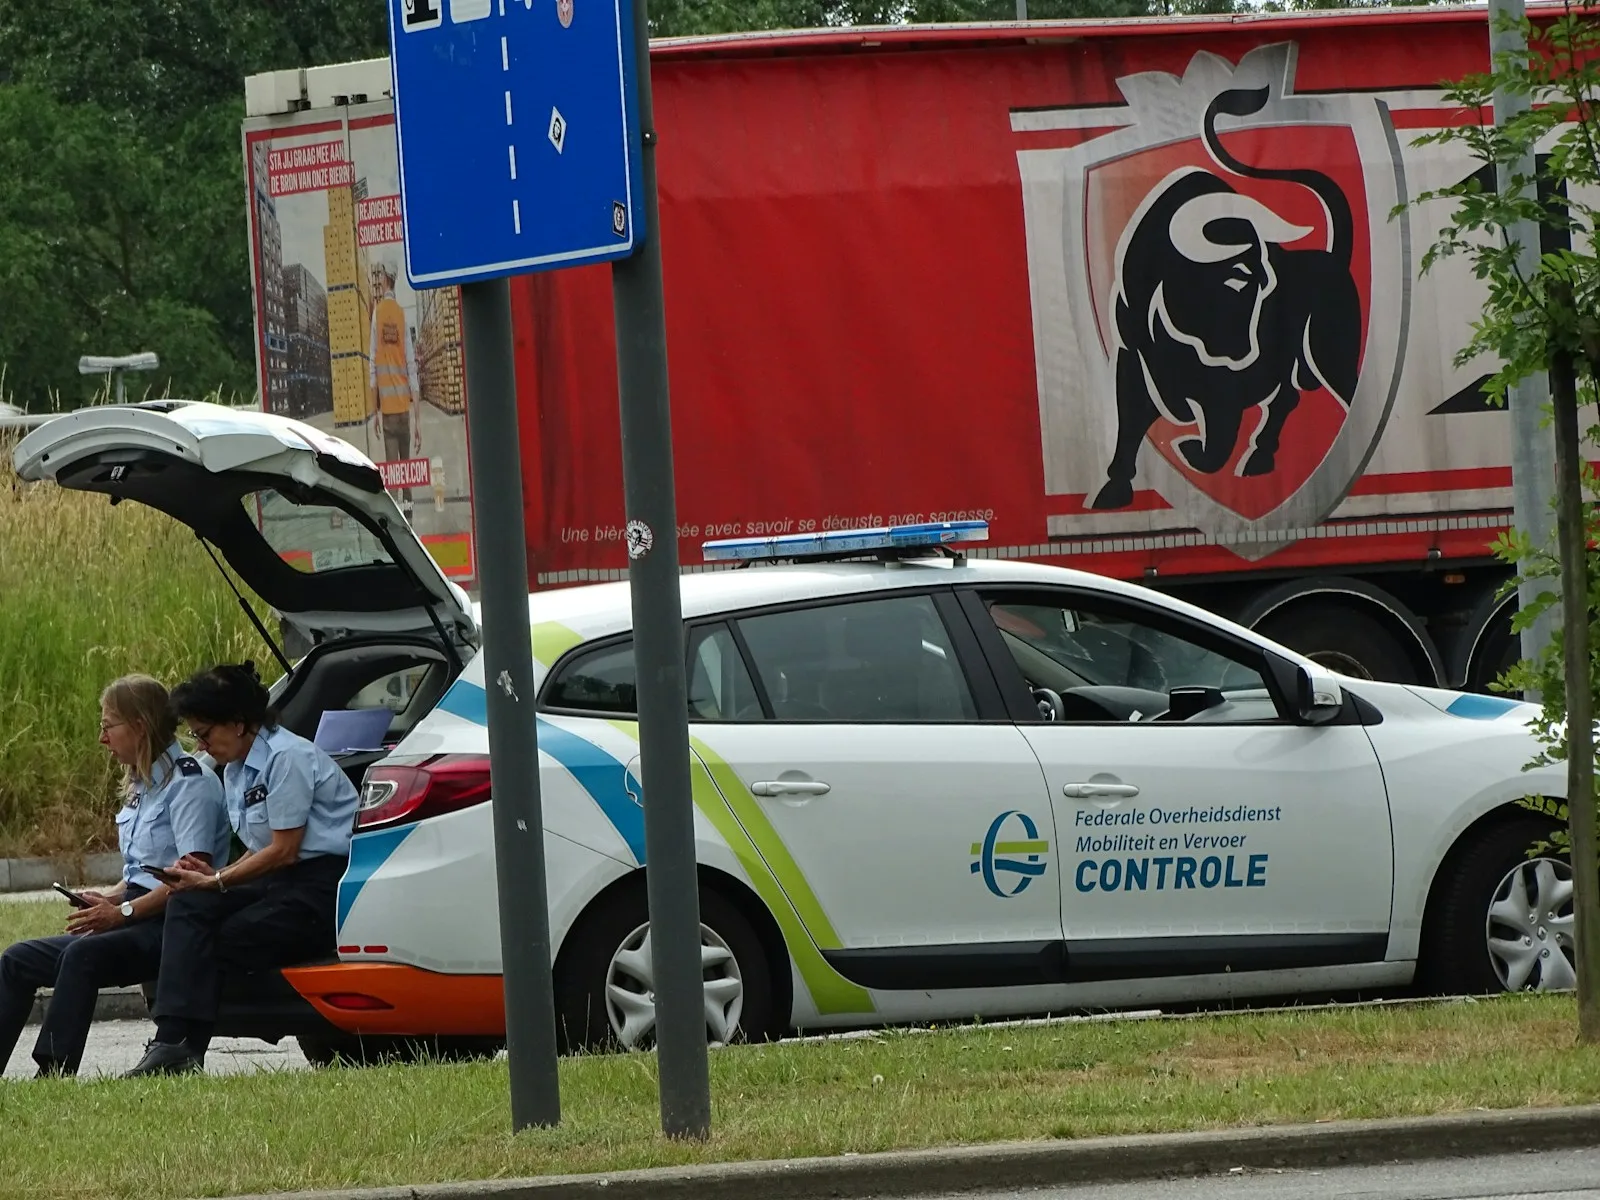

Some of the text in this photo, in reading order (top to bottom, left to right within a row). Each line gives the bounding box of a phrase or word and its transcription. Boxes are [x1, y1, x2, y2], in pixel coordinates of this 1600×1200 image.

[269, 142, 344, 171] STA JIJ GRAAG MEE AAN
[270, 175, 280, 194] DE
[280, 173, 298, 192] BRON
[298, 170, 312, 190] VAN
[312, 168, 329, 188] ONZE
[360, 220, 404, 244] SOURCE DE NO
[380, 461, 428, 486] B-INBEV.COM
[561, 527, 590, 544] Une
[705, 521, 741, 536] avec
[746, 517, 793, 536] savoir
[798, 518, 816, 532] se
[822, 512, 883, 530] déguste
[888, 513, 924, 528] avec
[1075, 805, 1282, 827] Federale Overheidsdienst
[1075, 832, 1247, 853] Mobiliteit en Vervoer
[1075, 853, 1269, 893] CONTROLE
